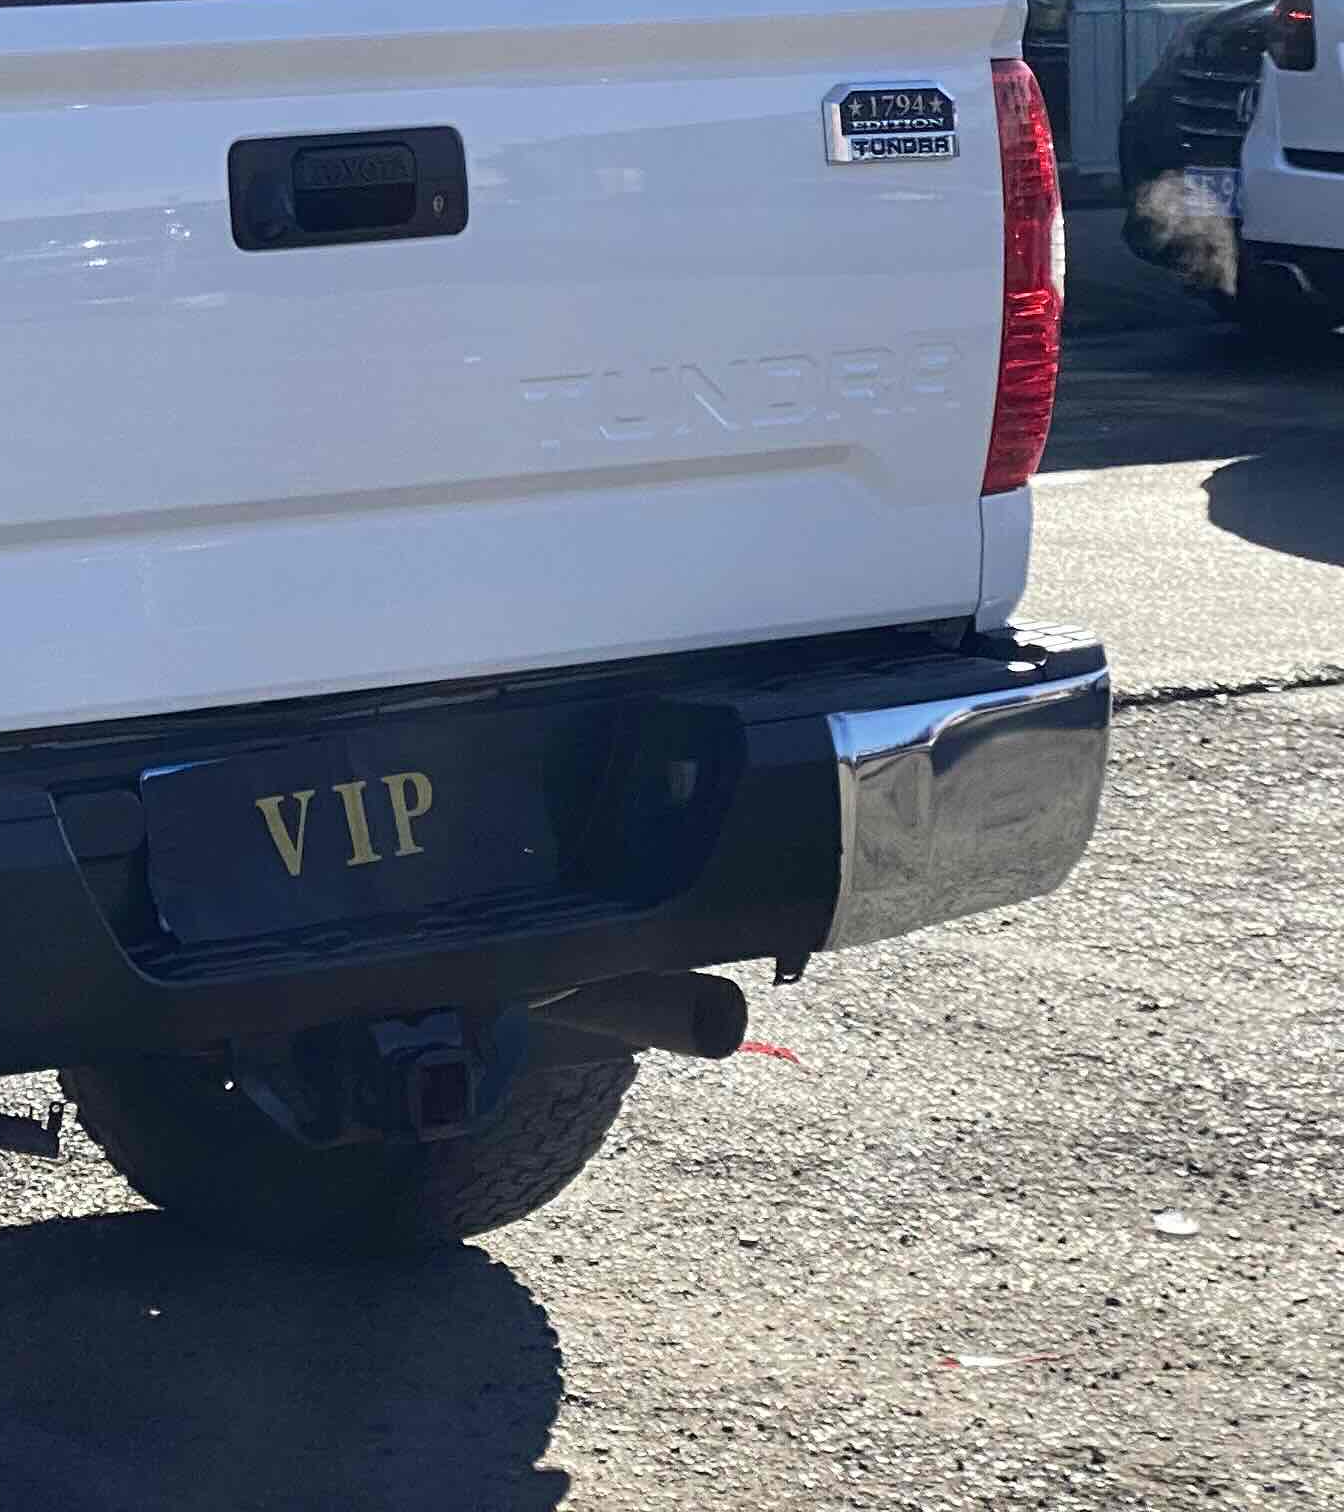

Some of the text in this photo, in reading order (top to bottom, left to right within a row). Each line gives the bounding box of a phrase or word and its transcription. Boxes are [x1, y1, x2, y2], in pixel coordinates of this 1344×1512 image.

[869, 94, 925, 117] 1794
[849, 118, 944, 132] EDITION
[850, 135, 950, 157] TUNDRA
[518, 334, 965, 451] TUNDRA
[254, 770, 435, 878] VIP
